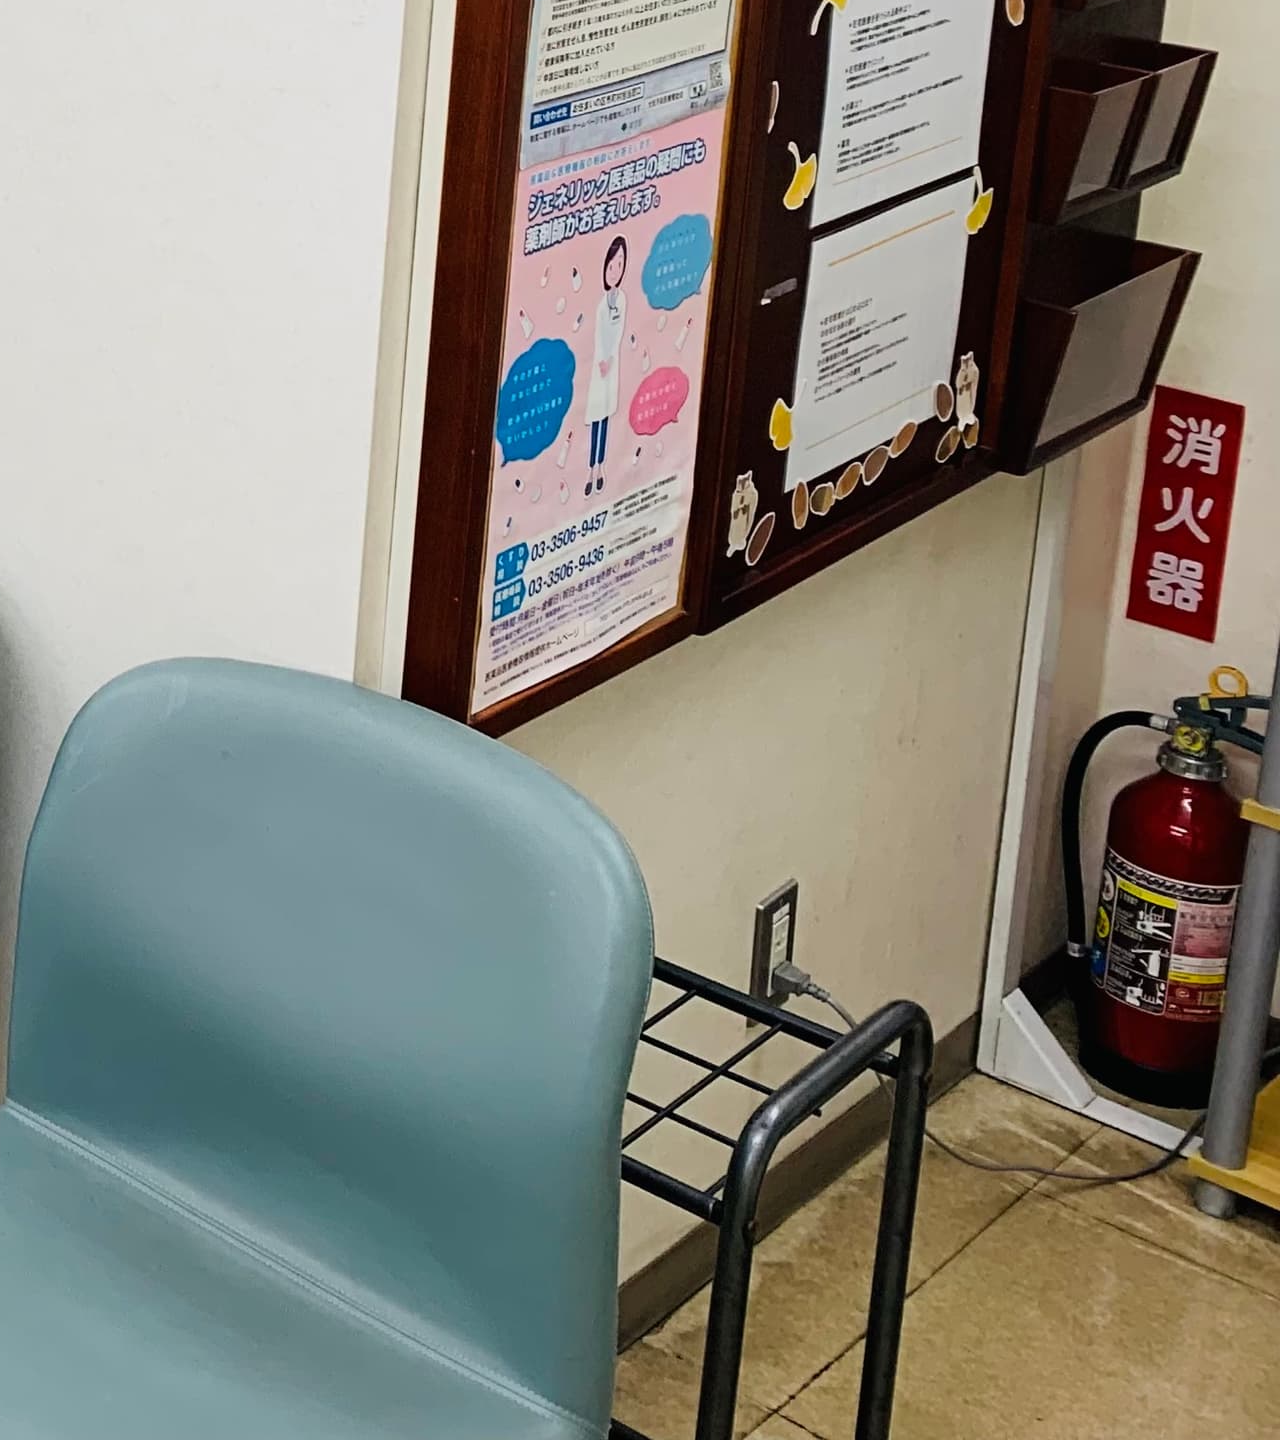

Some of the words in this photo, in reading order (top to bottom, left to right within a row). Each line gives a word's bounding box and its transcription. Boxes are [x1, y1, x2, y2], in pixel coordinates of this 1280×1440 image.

[527, 139, 706, 219] ジェネリック医薬品の疑問にも
[524, 185, 661, 255] 薬剤師がお答えします。
[530, 511, 608, 562] 03-3506-9457
[1147, 414, 1226, 613] 消火器
[528, 545, 605, 598] 03-3506-9436
